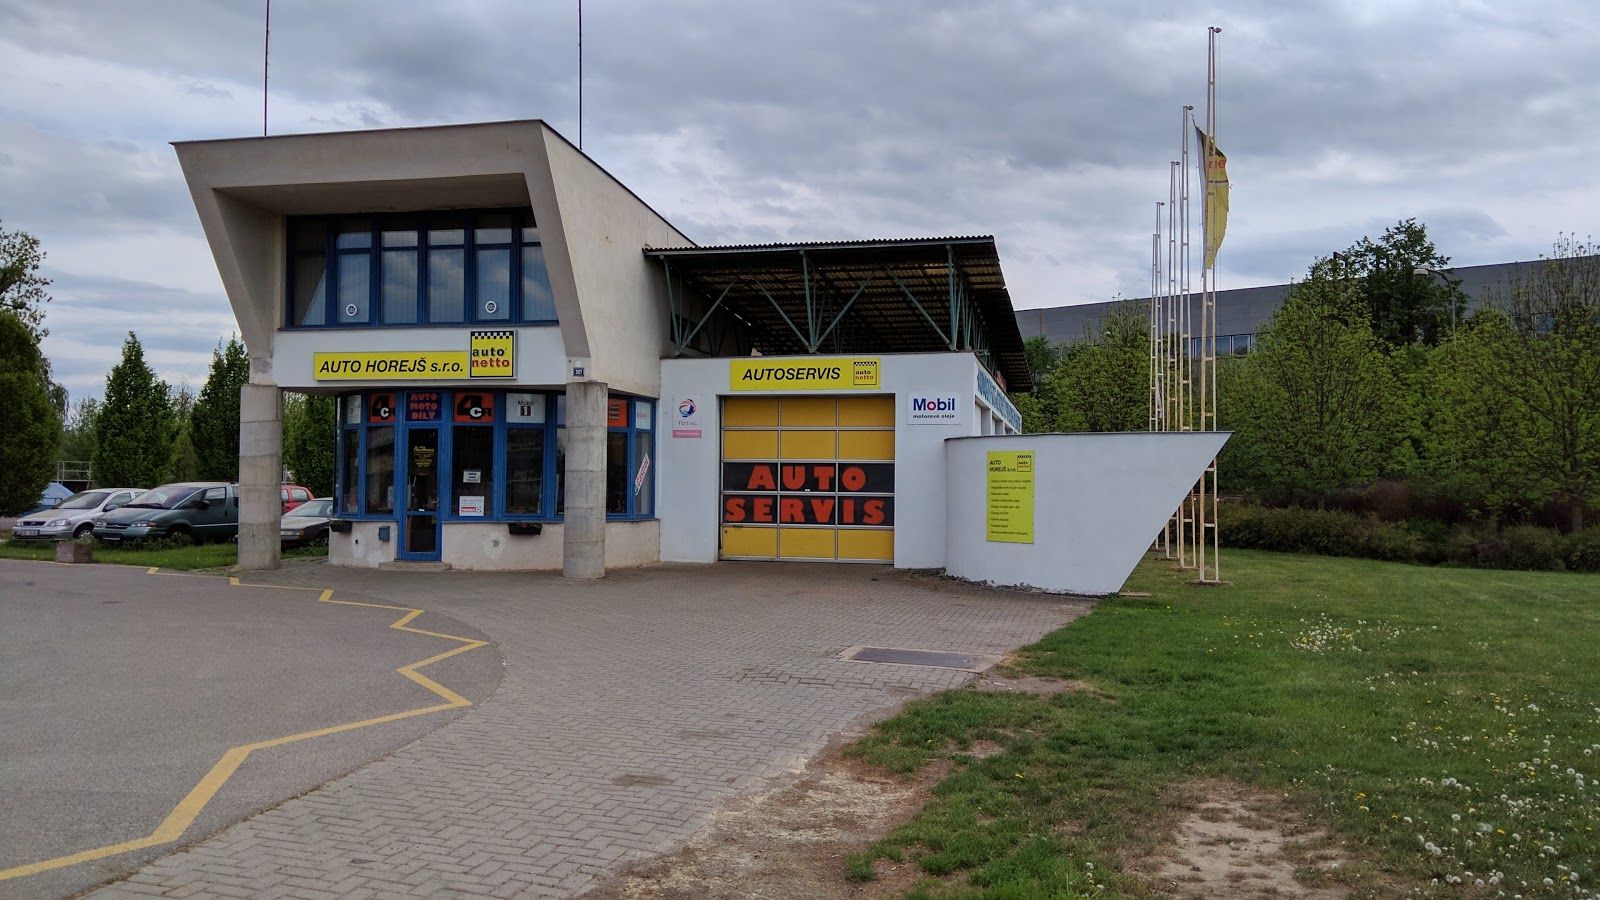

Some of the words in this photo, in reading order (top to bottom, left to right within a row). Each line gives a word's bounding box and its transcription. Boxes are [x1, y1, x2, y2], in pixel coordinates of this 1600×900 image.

[472, 347, 505, 357] auto
[319, 360, 361, 373] AUTO
[365, 357, 426, 373] HOREJŠ
[430, 361, 464, 372] s.r.o.
[472, 357, 510, 368] netto
[742, 367, 841, 381] AUTOSERVIS
[410, 402, 438, 410] MOTO
[913, 397, 955, 411] Mobil
[747, 464, 866, 491] AUTO
[725, 498, 885, 524] SERVIS
